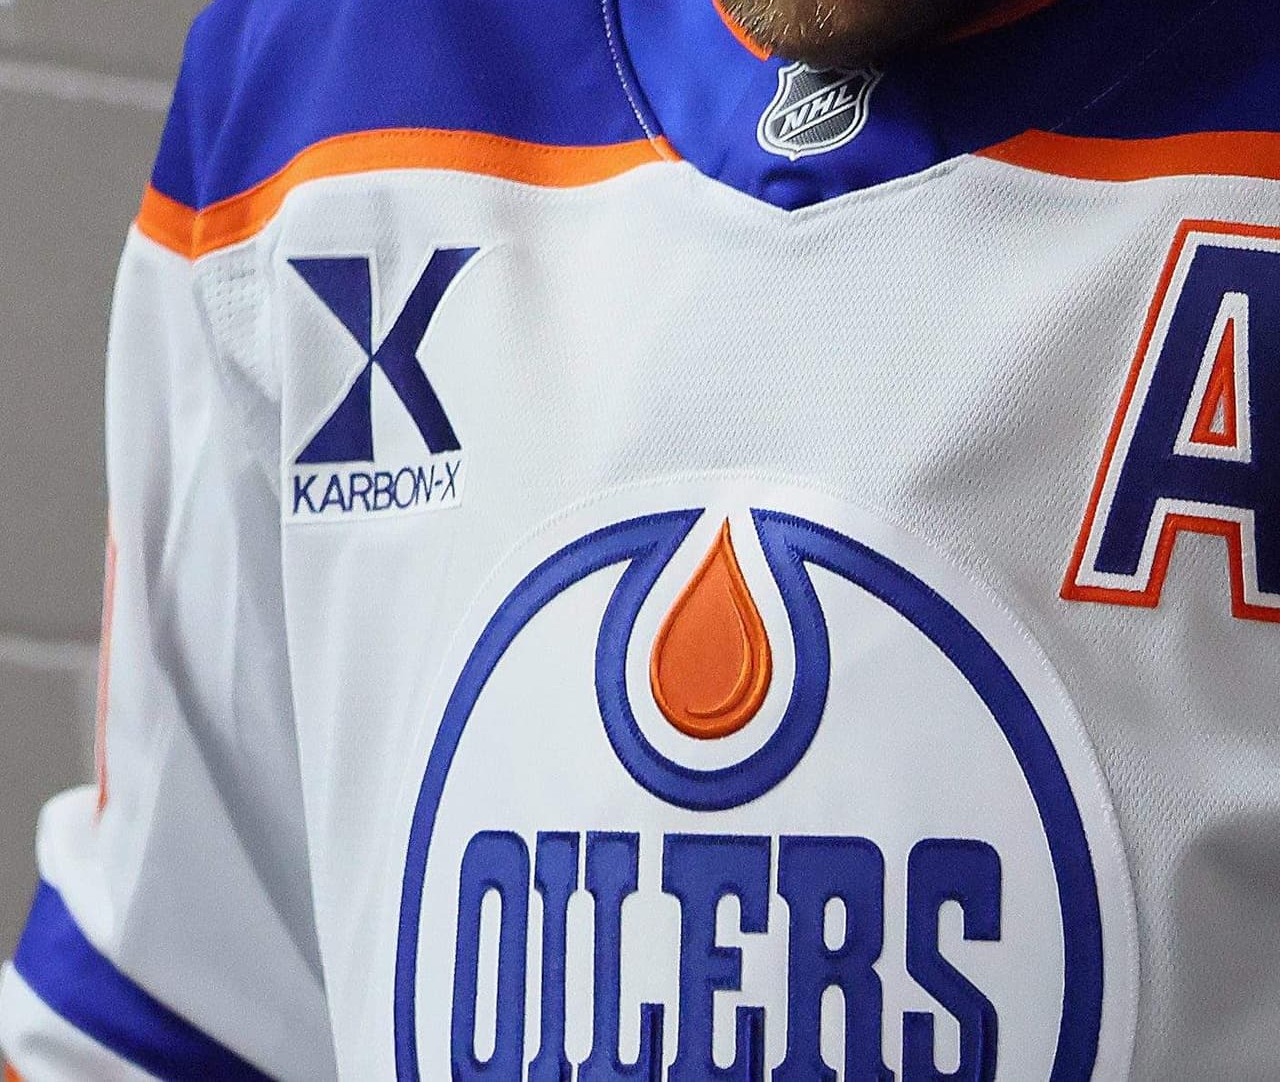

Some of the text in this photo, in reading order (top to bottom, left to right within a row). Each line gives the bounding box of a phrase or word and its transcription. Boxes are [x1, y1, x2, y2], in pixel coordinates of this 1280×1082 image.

[779, 85, 854, 138] NHL
[292, 461, 462, 514] KARBON-X
[451, 829, 1003, 1082] OILERS
